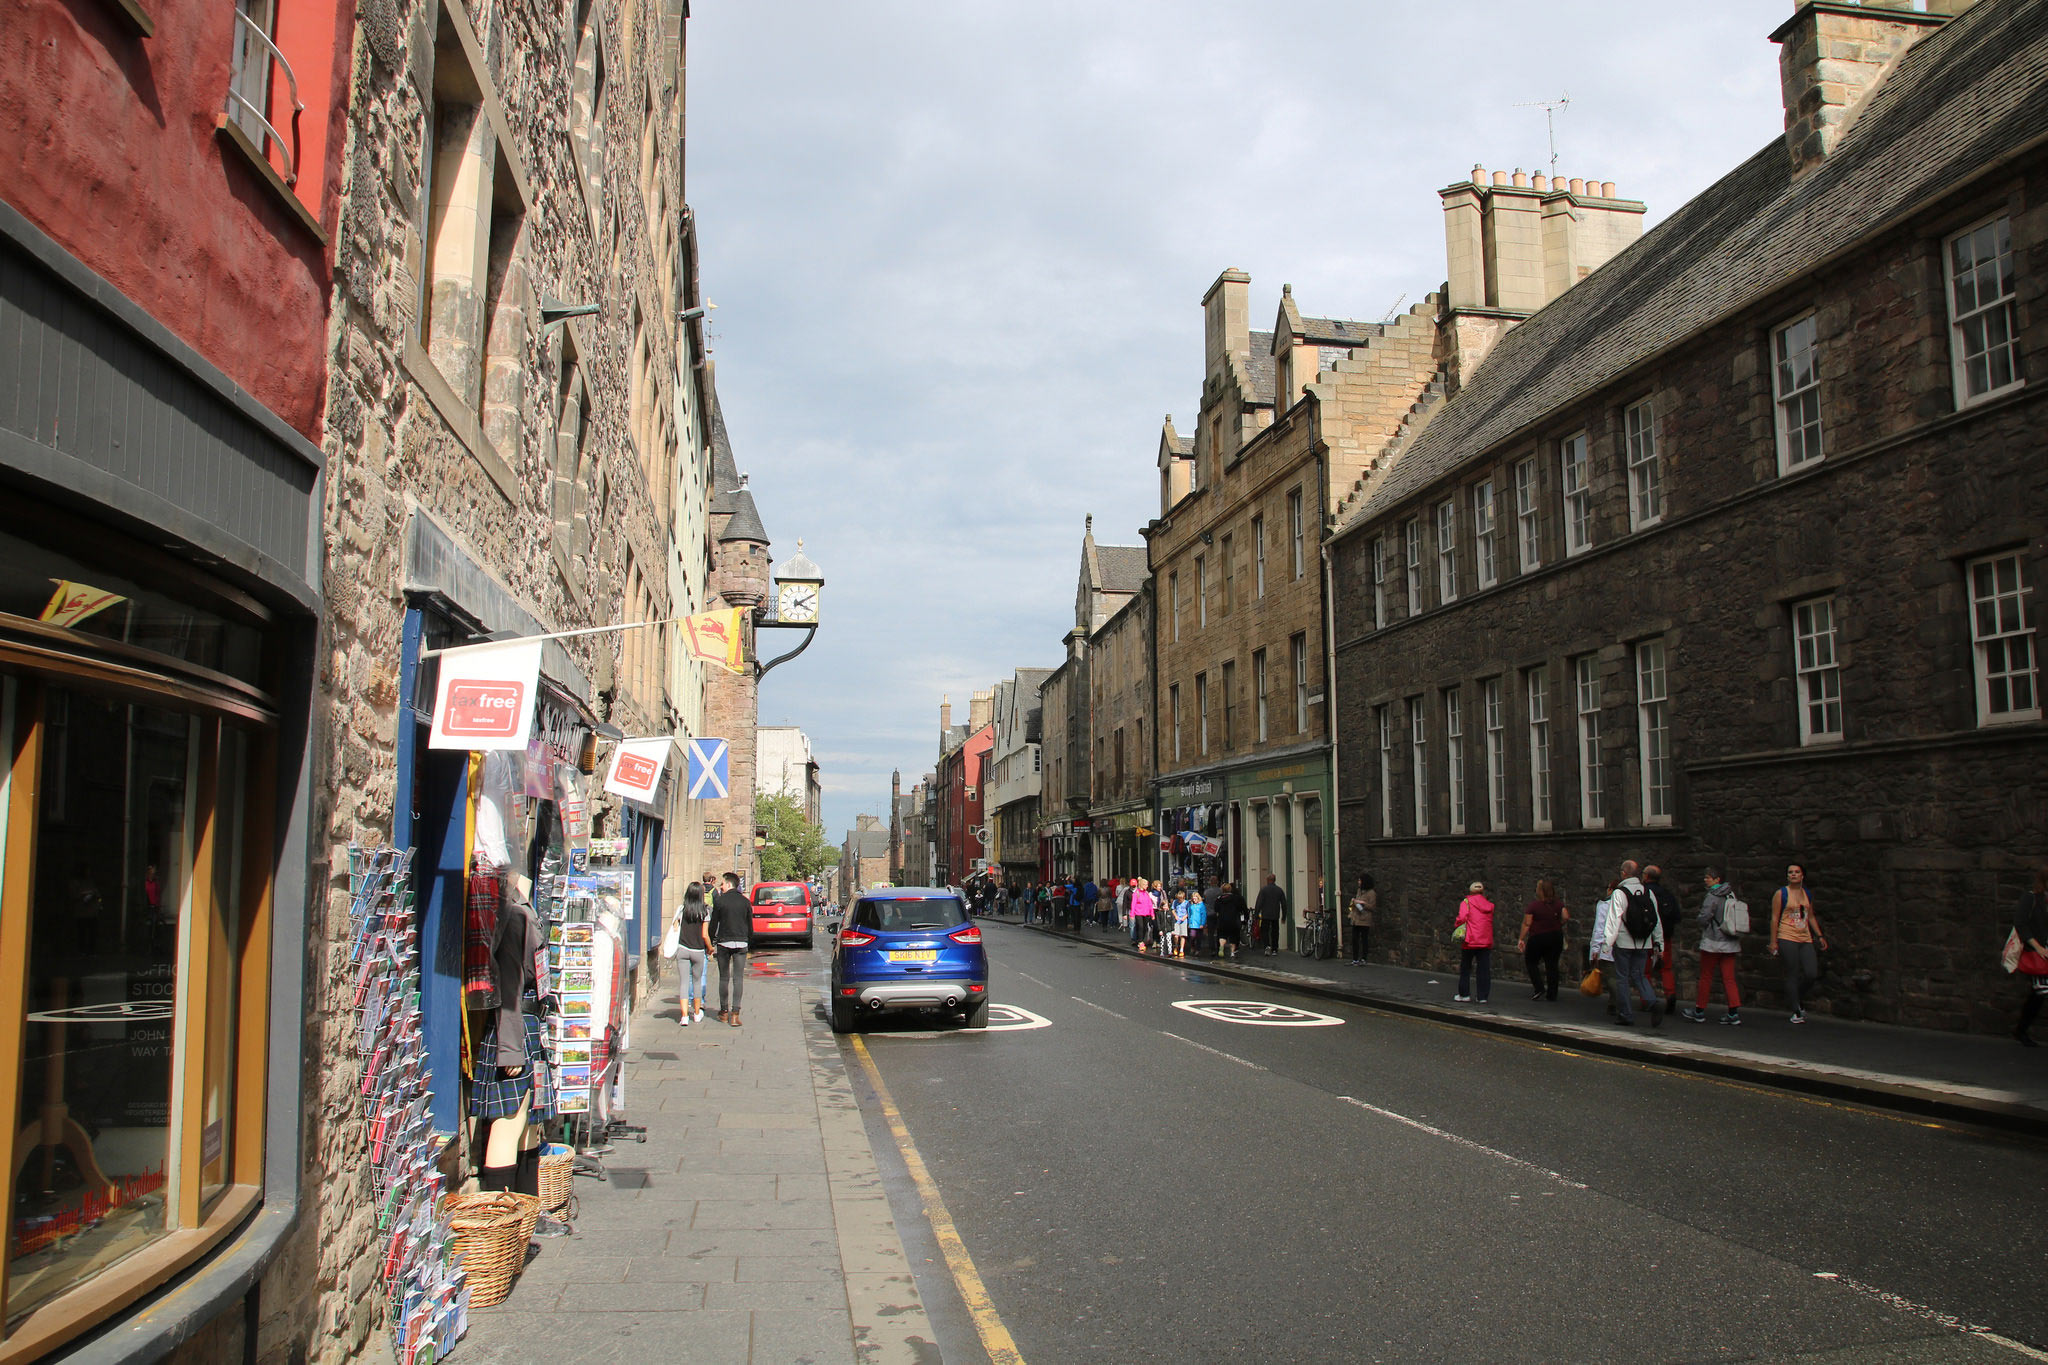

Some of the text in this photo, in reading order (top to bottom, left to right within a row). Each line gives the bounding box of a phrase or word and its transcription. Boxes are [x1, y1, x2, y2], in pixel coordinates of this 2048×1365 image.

[452, 693, 516, 709] taxfree
[130, 1030, 165, 1041] JOHN
[131, 1047, 158, 1057] WAY
[82, 1185, 111, 1225] Made
[125, 1159, 164, 1203] Scotland
